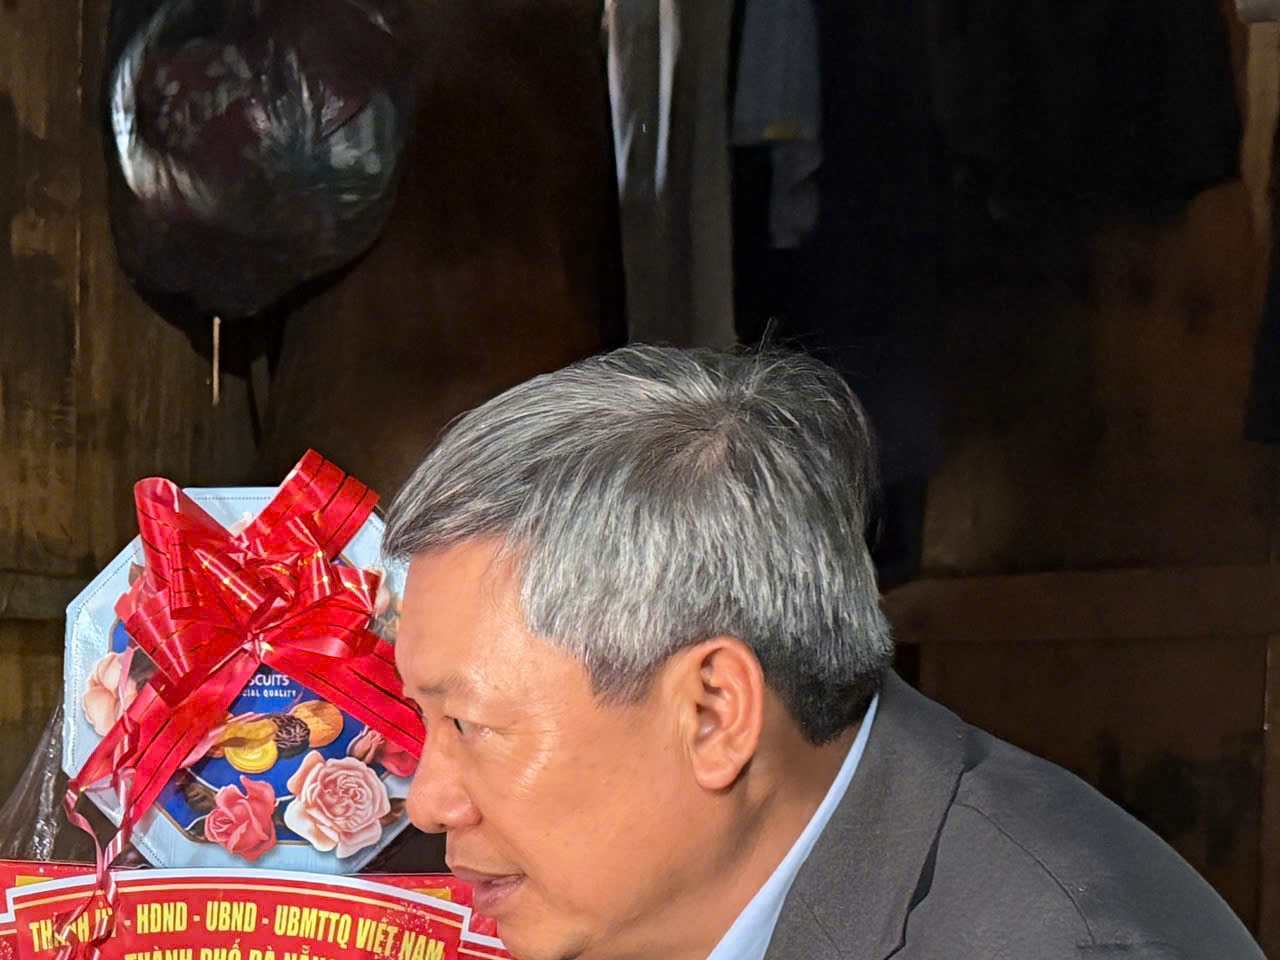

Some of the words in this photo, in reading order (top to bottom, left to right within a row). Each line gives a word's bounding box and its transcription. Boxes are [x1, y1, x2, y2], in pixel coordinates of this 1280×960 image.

[248, 674, 290, 686] SCUITS
[242, 688, 261, 698] CIAL
[263, 689, 297, 698] QUALITY
[137, 902, 188, 934] HĐND
[206, 901, 257, 933] UBND
[273, 904, 352, 949] UBMTTQ
